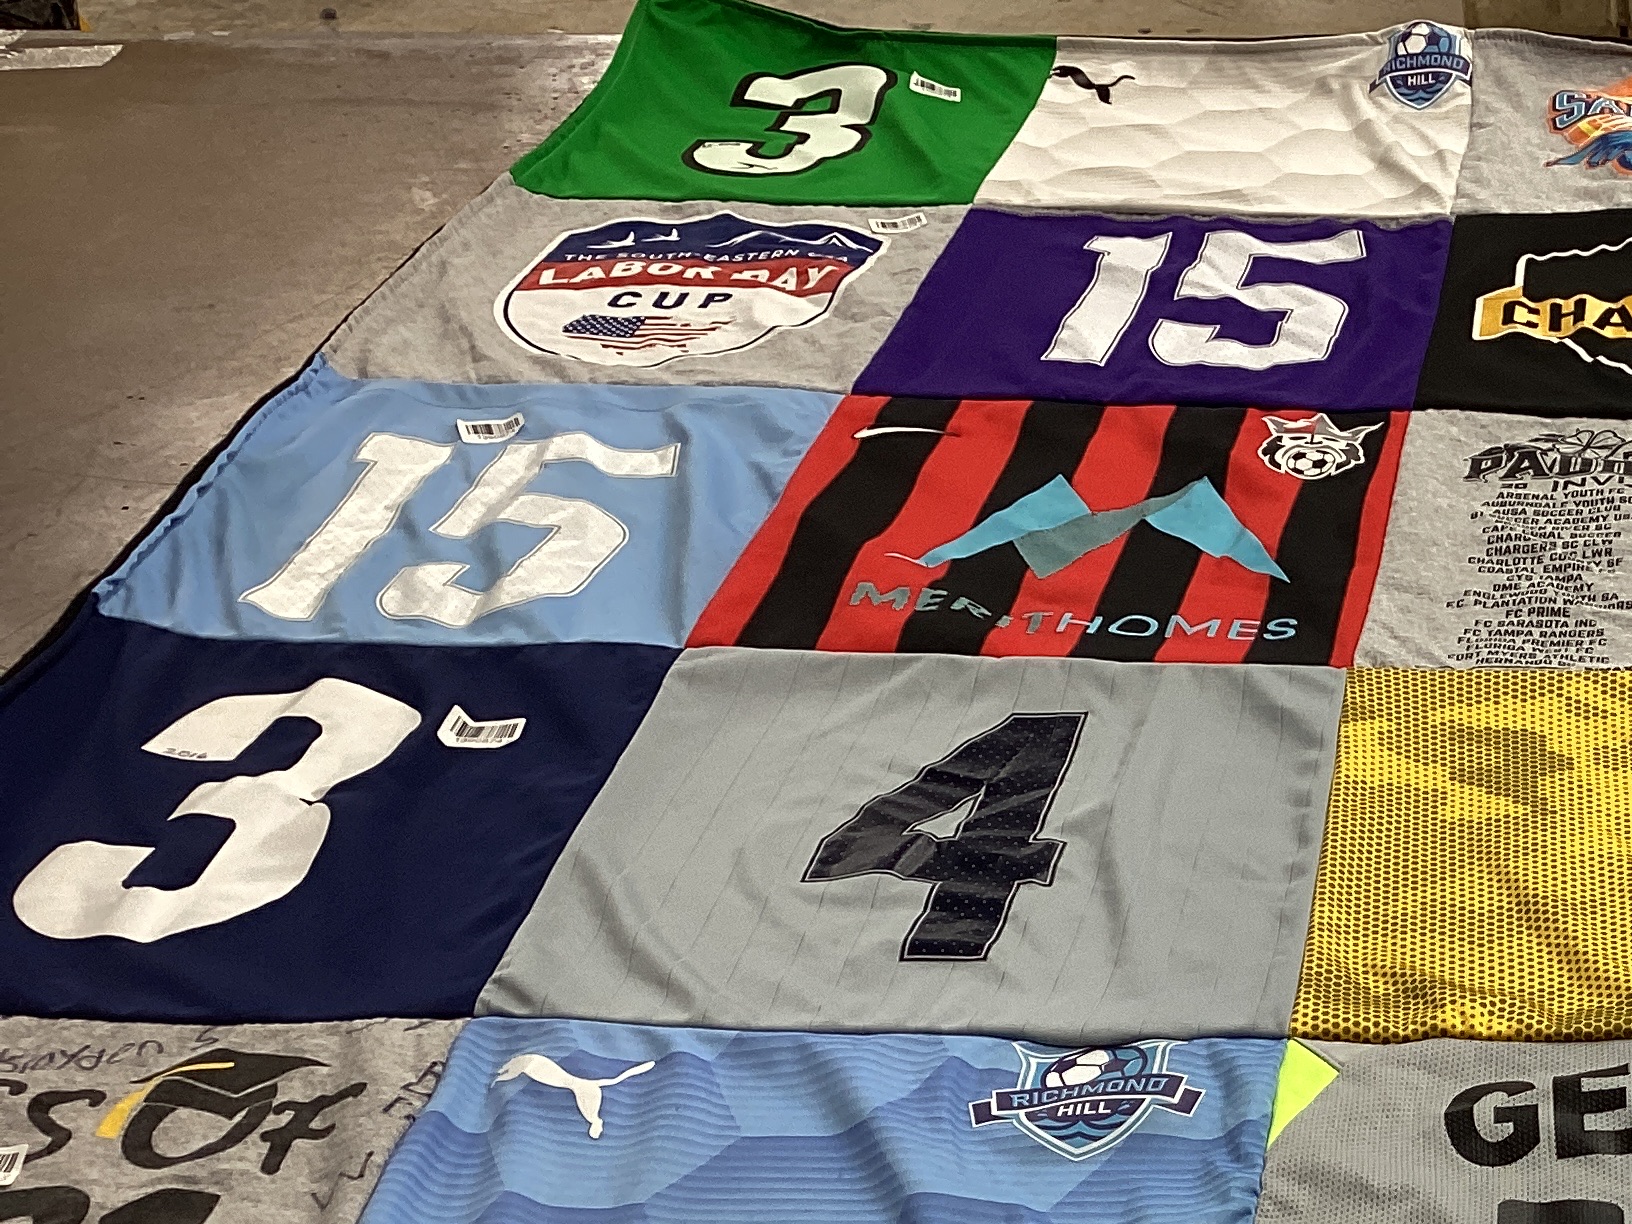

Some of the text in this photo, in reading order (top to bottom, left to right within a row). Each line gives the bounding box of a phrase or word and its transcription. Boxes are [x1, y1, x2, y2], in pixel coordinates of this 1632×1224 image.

[1408, 73, 1436, 86] HILL
[681, 62, 897, 176] 3
[540, 261, 723, 285] LABOR
[606, 291, 734, 310] CUP
[1040, 229, 1367, 371] 15
[1496, 489, 1604, 501] ARSENAL YOUTH
[1573, 496, 1615, 508] YOUTH
[1492, 508, 1528, 516] AUSA
[1533, 509, 1584, 517] SOCCER
[1588, 505, 1621, 515] CLUB
[1545, 514, 1609, 525] ACADEMY
[237, 430, 682, 629] 15
[1468, 555, 1545, 566] CHARLOTTE
[1473, 596, 1557, 609] PLANTATION
[1505, 607, 1570, 618] FC PRIME
[1474, 619, 1597, 628] FC SARASOTA IND
[1463, 628, 1605, 638] FC TAMPA RANGERS
[12, 677, 422, 943] 3
[800, 711, 1089, 962] 4
[1009, 1077, 1169, 1107] RICHMOND
[1057, 1101, 1112, 1117] HILL
